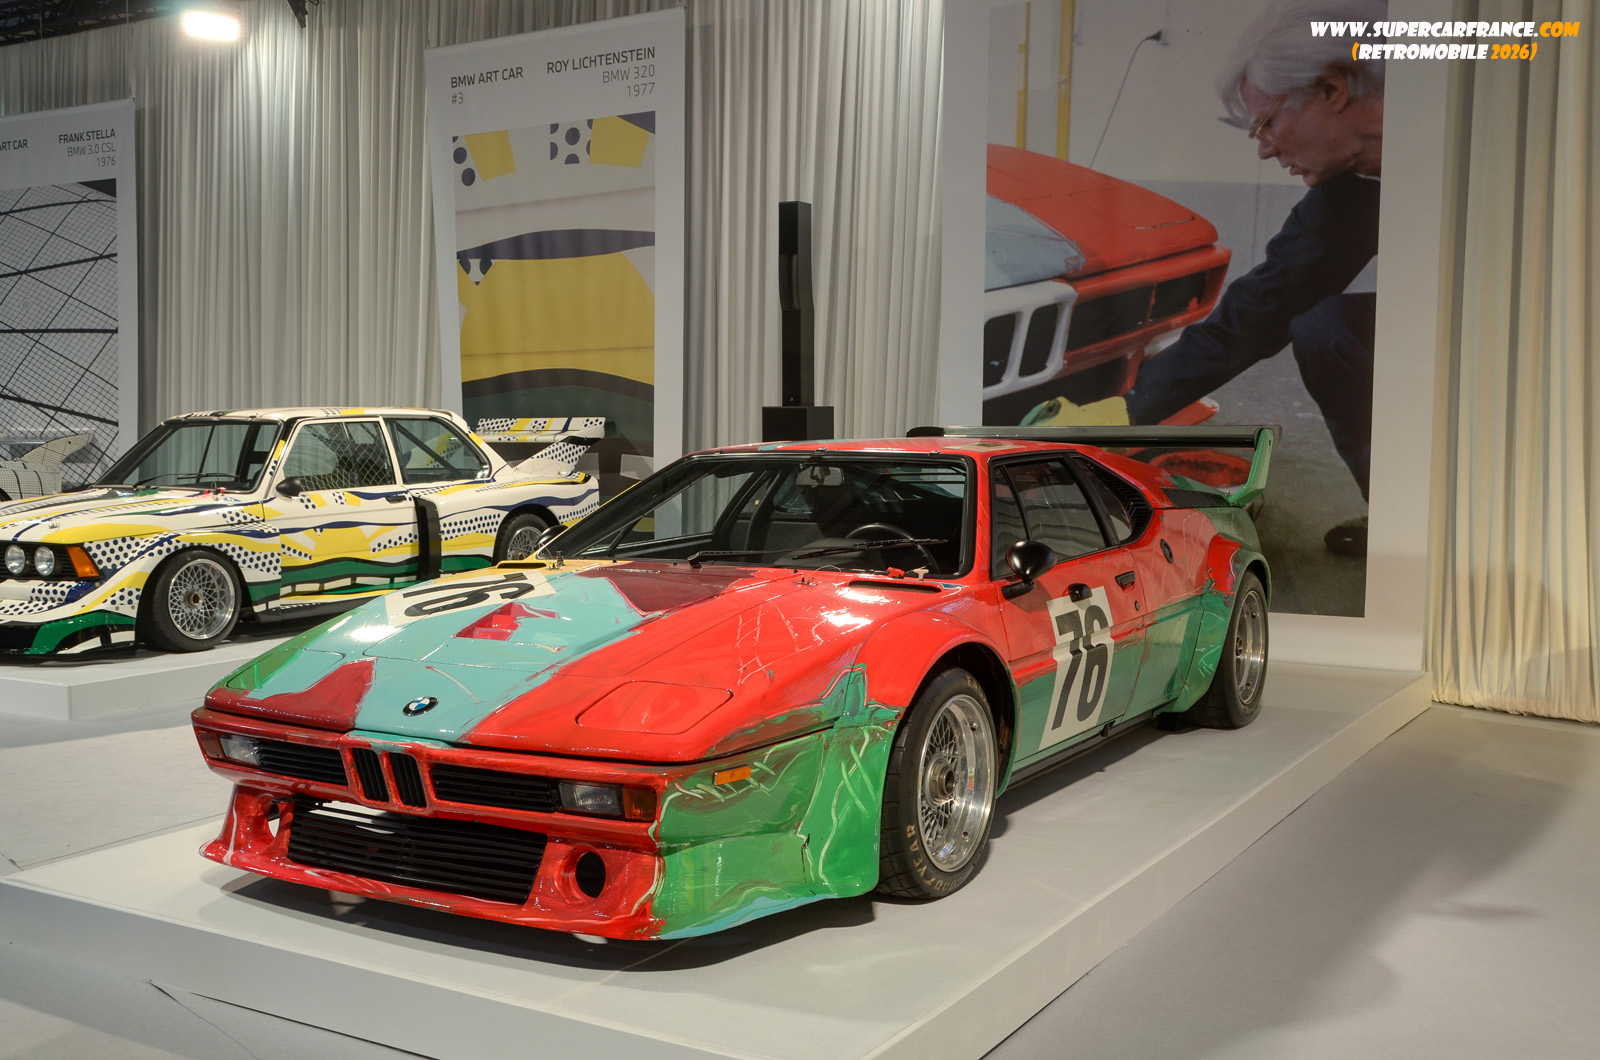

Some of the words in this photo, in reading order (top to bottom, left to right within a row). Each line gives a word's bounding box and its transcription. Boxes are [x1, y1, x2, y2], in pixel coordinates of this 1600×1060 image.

[547, 59, 569, 74] ROY
[572, 46, 656, 70] LICHTENSTEIN
[451, 74, 476, 88] BMW
[477, 70, 500, 84] ART
[501, 66, 523, 81] CAR
[602, 68, 631, 84] BMW
[633, 64, 656, 80] 320
[627, 82, 656, 98] 1977
[451, 92, 464, 105] #3
[13, 139, 28, 149] CAR
[59, 131, 85, 144] FRANK
[86, 128, 116, 142] STELLA
[68, 146, 86, 157] BMW
[88, 144, 99, 155] 3.0
[101, 142, 116, 153] CSL
[97, 155, 116, 167] 1976
[1051, 605, 1109, 731] 76
